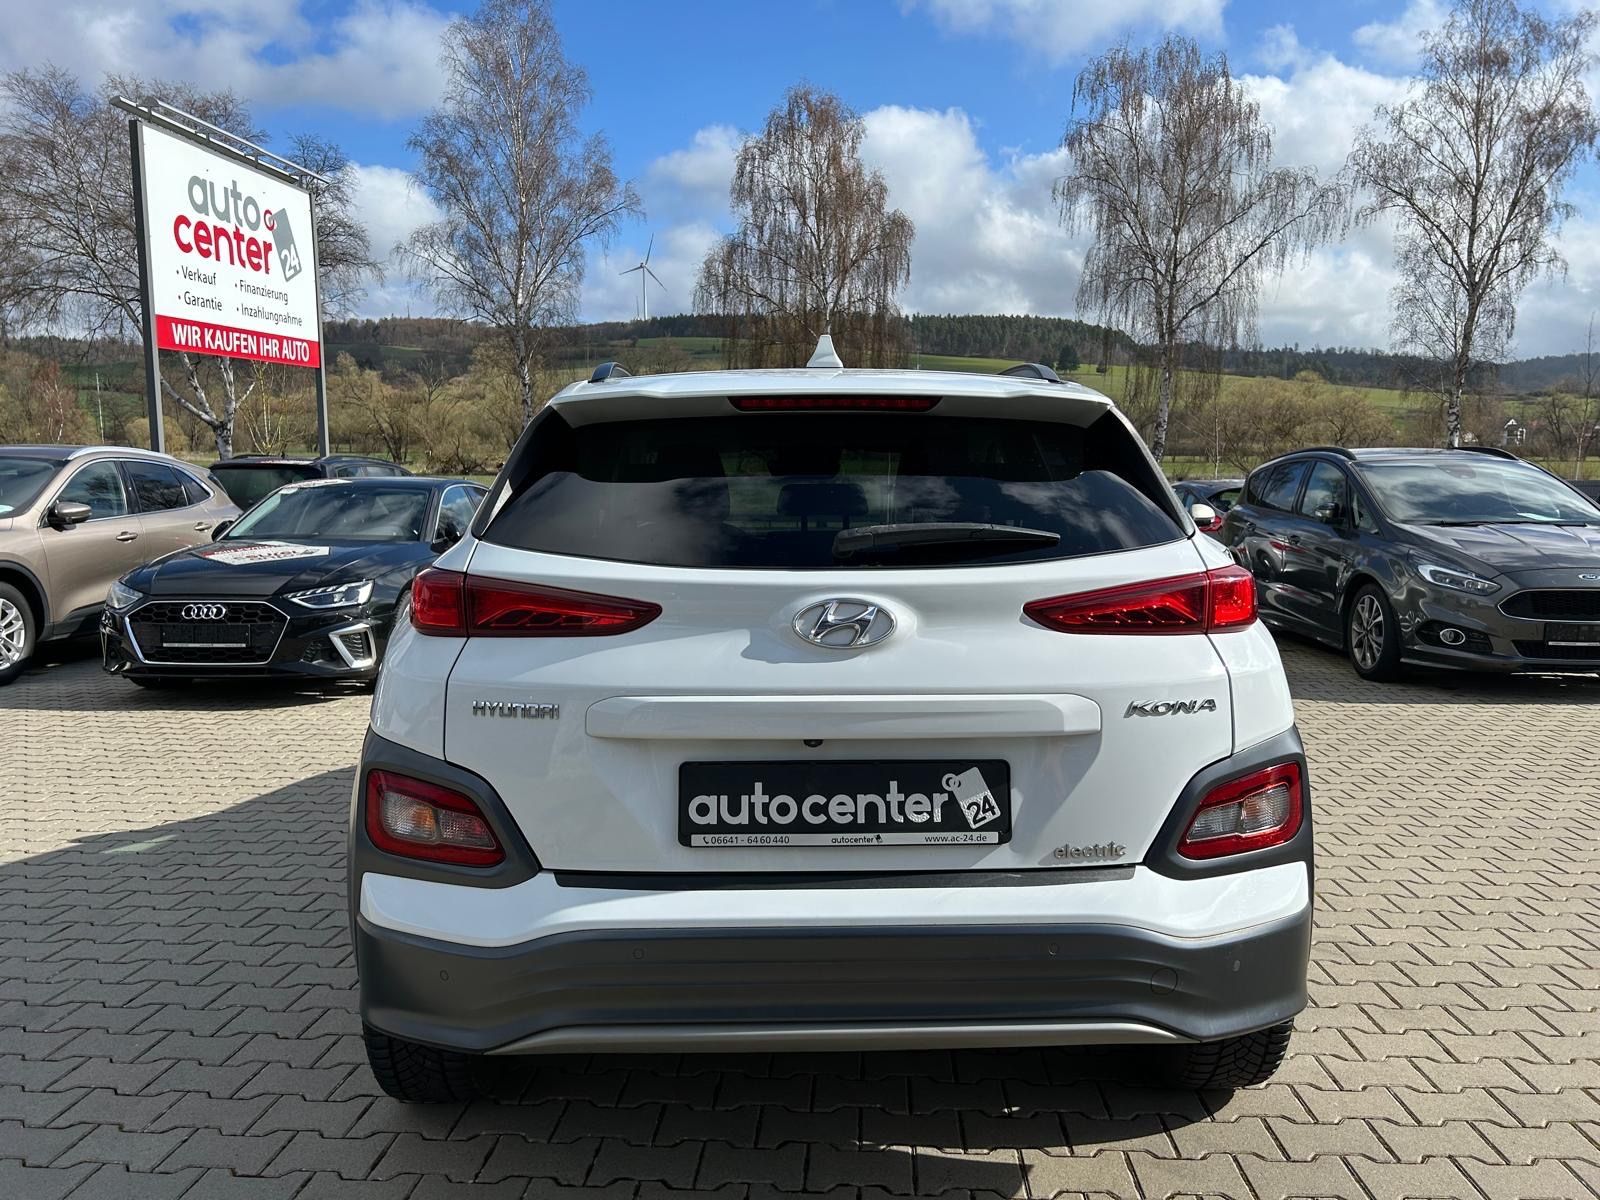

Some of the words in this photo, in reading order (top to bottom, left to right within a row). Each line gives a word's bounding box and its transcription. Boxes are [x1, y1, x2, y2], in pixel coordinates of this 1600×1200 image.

[187, 174, 261, 232] auto
[173, 214, 273, 275] center
[281, 243, 300, 277] 24
[181, 265, 217, 286] Verkauf
[183, 291, 223, 312] Garantie
[239, 279, 289, 306] Finanzierung
[241, 303, 303, 327] Inzahlungnahme
[171, 322, 202, 348] WIR
[204, 328, 257, 356] KAUFEN
[259, 337, 280, 358] IHR
[281, 340, 311, 363] AUTO
[472, 700, 560, 720] HYUNDAI
[1123, 698, 1217, 719] KONA
[966, 800, 997, 825] 24
[709, 835, 739, 845] 06641
[831, 836, 875, 845] autocenter
[924, 833, 988, 844] www.ac-24.de
[1052, 840, 1127, 860] electric
